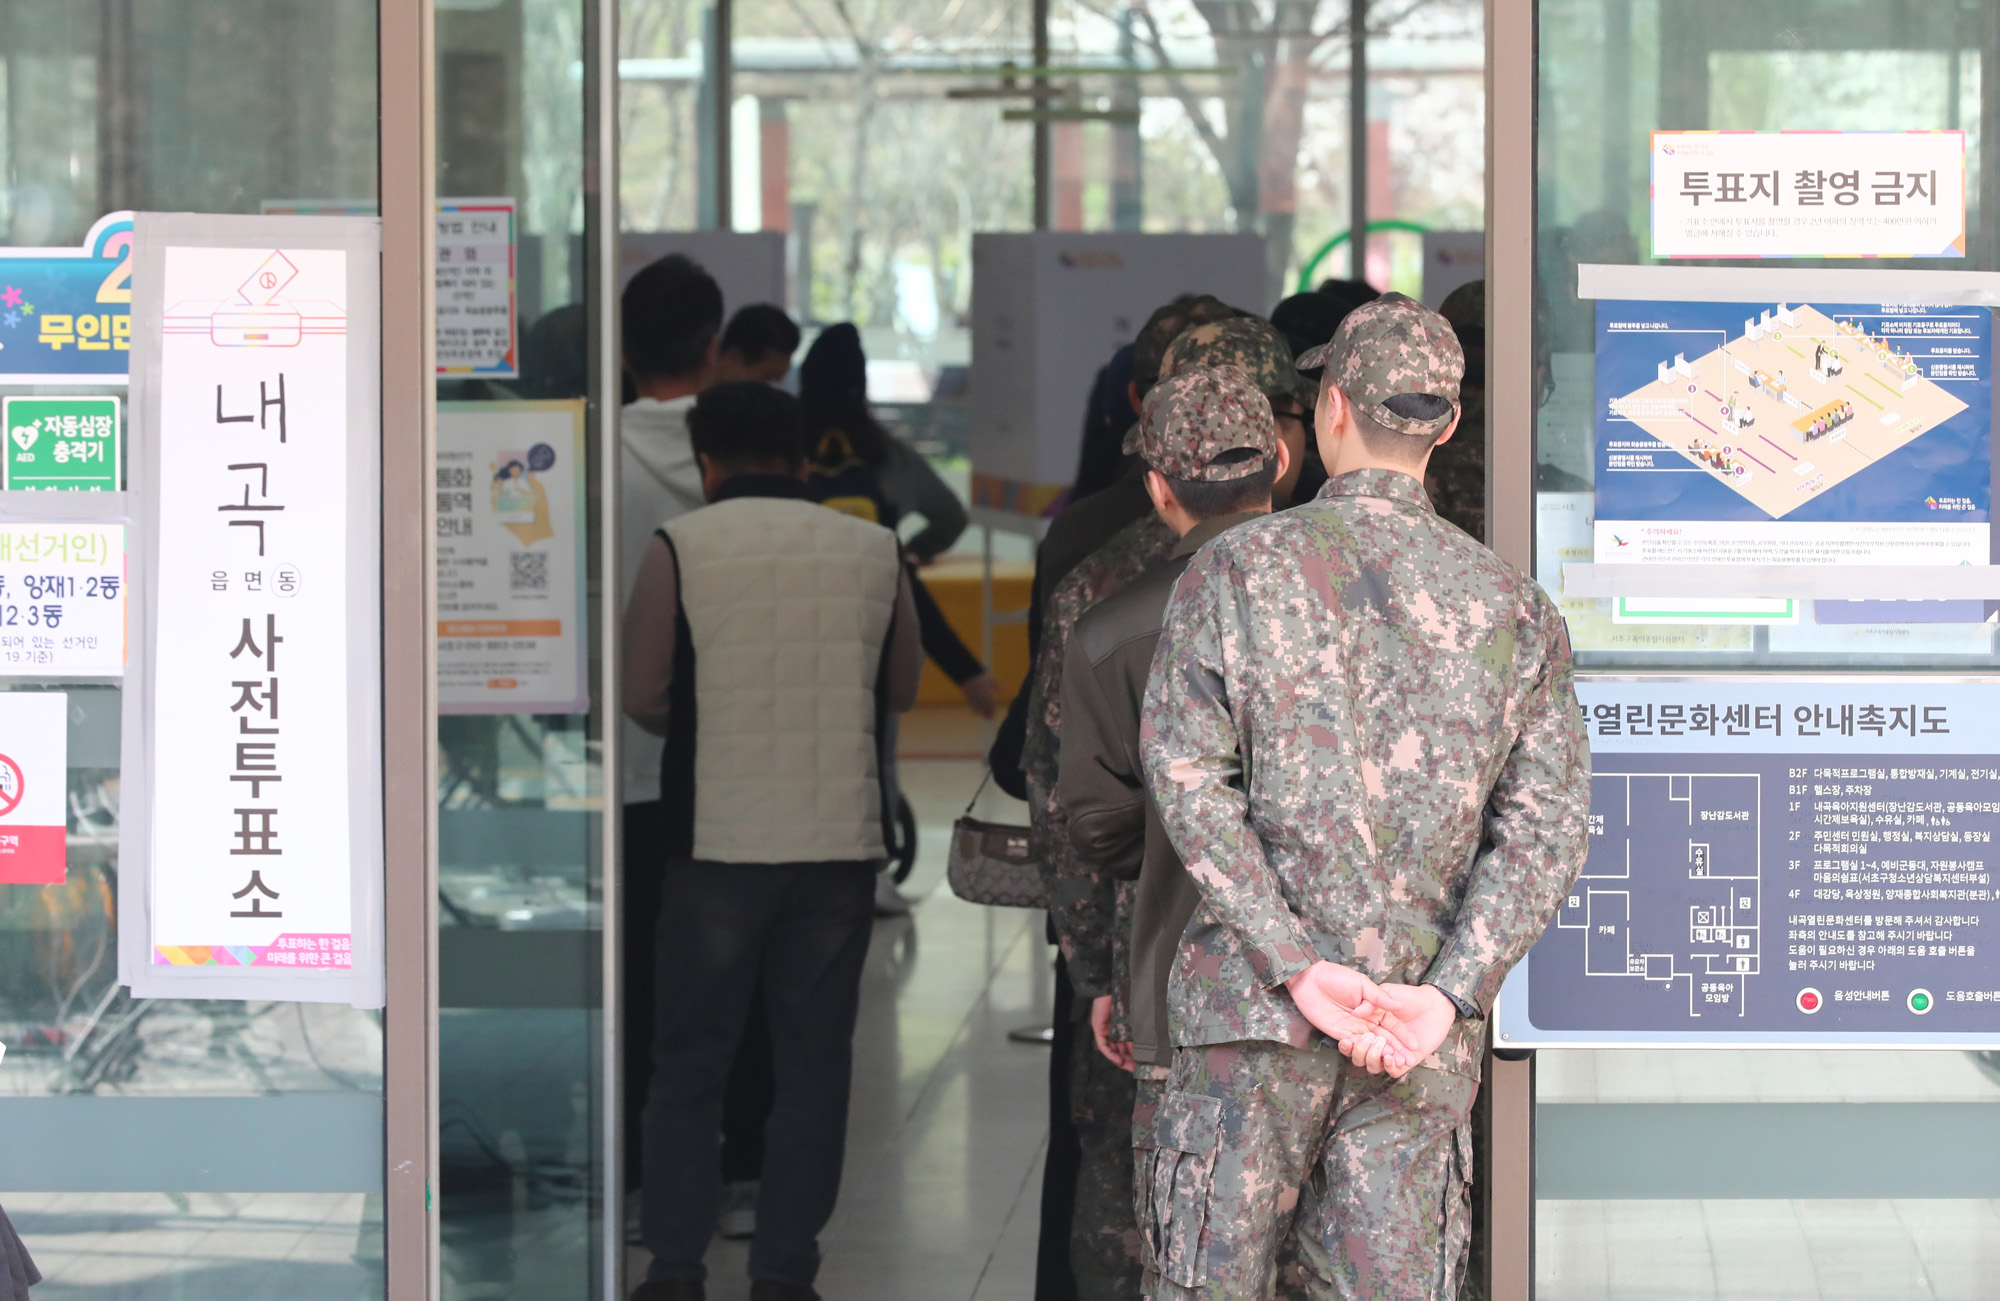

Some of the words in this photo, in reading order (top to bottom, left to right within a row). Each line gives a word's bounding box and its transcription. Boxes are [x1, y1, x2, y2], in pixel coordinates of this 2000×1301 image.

[1680, 170, 1780, 206] 투표지
[1794, 170, 1859, 206] 촬영
[1871, 170, 1937, 206] 금지
[44, 415, 113, 438] 자동심장
[16, 452, 35, 463] AED
[53, 440, 104, 463] 충격기
[217, 373, 286, 556] 내곡
[210, 570, 229, 592] 읍
[245, 570, 262, 592] 면
[278, 570, 297, 592] 동
[1794, 703, 1951, 737] 안내촉지도
[229, 613, 283, 918] 사전투표소
[1789, 768, 1808, 780] B2F
[1814, 768, 1888, 780] 다목적프로그램실,
[1890, 768, 1938, 780] 통합방재실,
[1939, 768, 1969, 780] 기계실,
[1789, 785, 1808, 796] B1F
[1814, 785, 1844, 796] 헬스장,
[1845, 785, 1873, 796] 주차장
[1789, 802, 1800, 814] 1F
[1701, 811, 1750, 821] 장난감도서관
[1875, 814, 1905, 826] 수유실,
[1907, 814, 1925, 826] 카페
[1789, 831, 1800, 842] 2F
[1814, 831, 1850, 842] 주민센터
[1852, 831, 1881, 842] 민원실,
[1883, 831, 1912, 842] 행정실,
[1915, 831, 1962, 842] 복지상담실,
[1964, 831, 1990, 842] 동장실
[1814, 843, 1867, 855] 다목적회의실
[1789, 860, 1800, 871] 3F
[1814, 860, 1858, 871] 프로그램실
[1881, 860, 1928, 871] 예비군동대,
[1931, 860, 1984, 871] 자원봉사캠프
[1789, 889, 1800, 901] 4F
[1814, 889, 1844, 901] 대강당,
[1845, 889, 1884, 901] 옥상정원,
[1789, 915, 1872, 926] 내곡열린문화센터를
[1875, 915, 1902, 926] 방문해
[1905, 915, 1932, 926] 주셔서
[1935, 915, 1979, 926] 감사합니다
[1599, 925, 1615, 935] 카페
[1789, 930, 1816, 941] 좌측의
[1819, 930, 1855, 941] 안내도를
[1858, 930, 1885, 941] 참고해
[1888, 930, 1914, 941] 주시기
[1917, 930, 1952, 941] 바랍니다
[277, 937, 317, 951] 투표하는
[318, 937, 330, 951] 한
[331, 937, 351, 951] 걸음
[1789, 945, 1816, 956] 도움이
[1819, 945, 1855, 956] 필요하신
[1858, 945, 1875, 956] 경우
[1878, 945, 1905, 956] 아래의
[1908, 945, 1926, 956] 도움
[1929, 945, 1947, 956] 호출
[1949, 945, 1976, 956] 버튼을
[1789, 960, 1807, 970] 눌러
[1810, 960, 1837, 970] 주시기
[1840, 960, 1875, 970] 바랍니다
[1701, 983, 1734, 993] 공동육아
[1705, 994, 1730, 1003] 모임방
[1834, 990, 1891, 1002] 음성안내버튼
